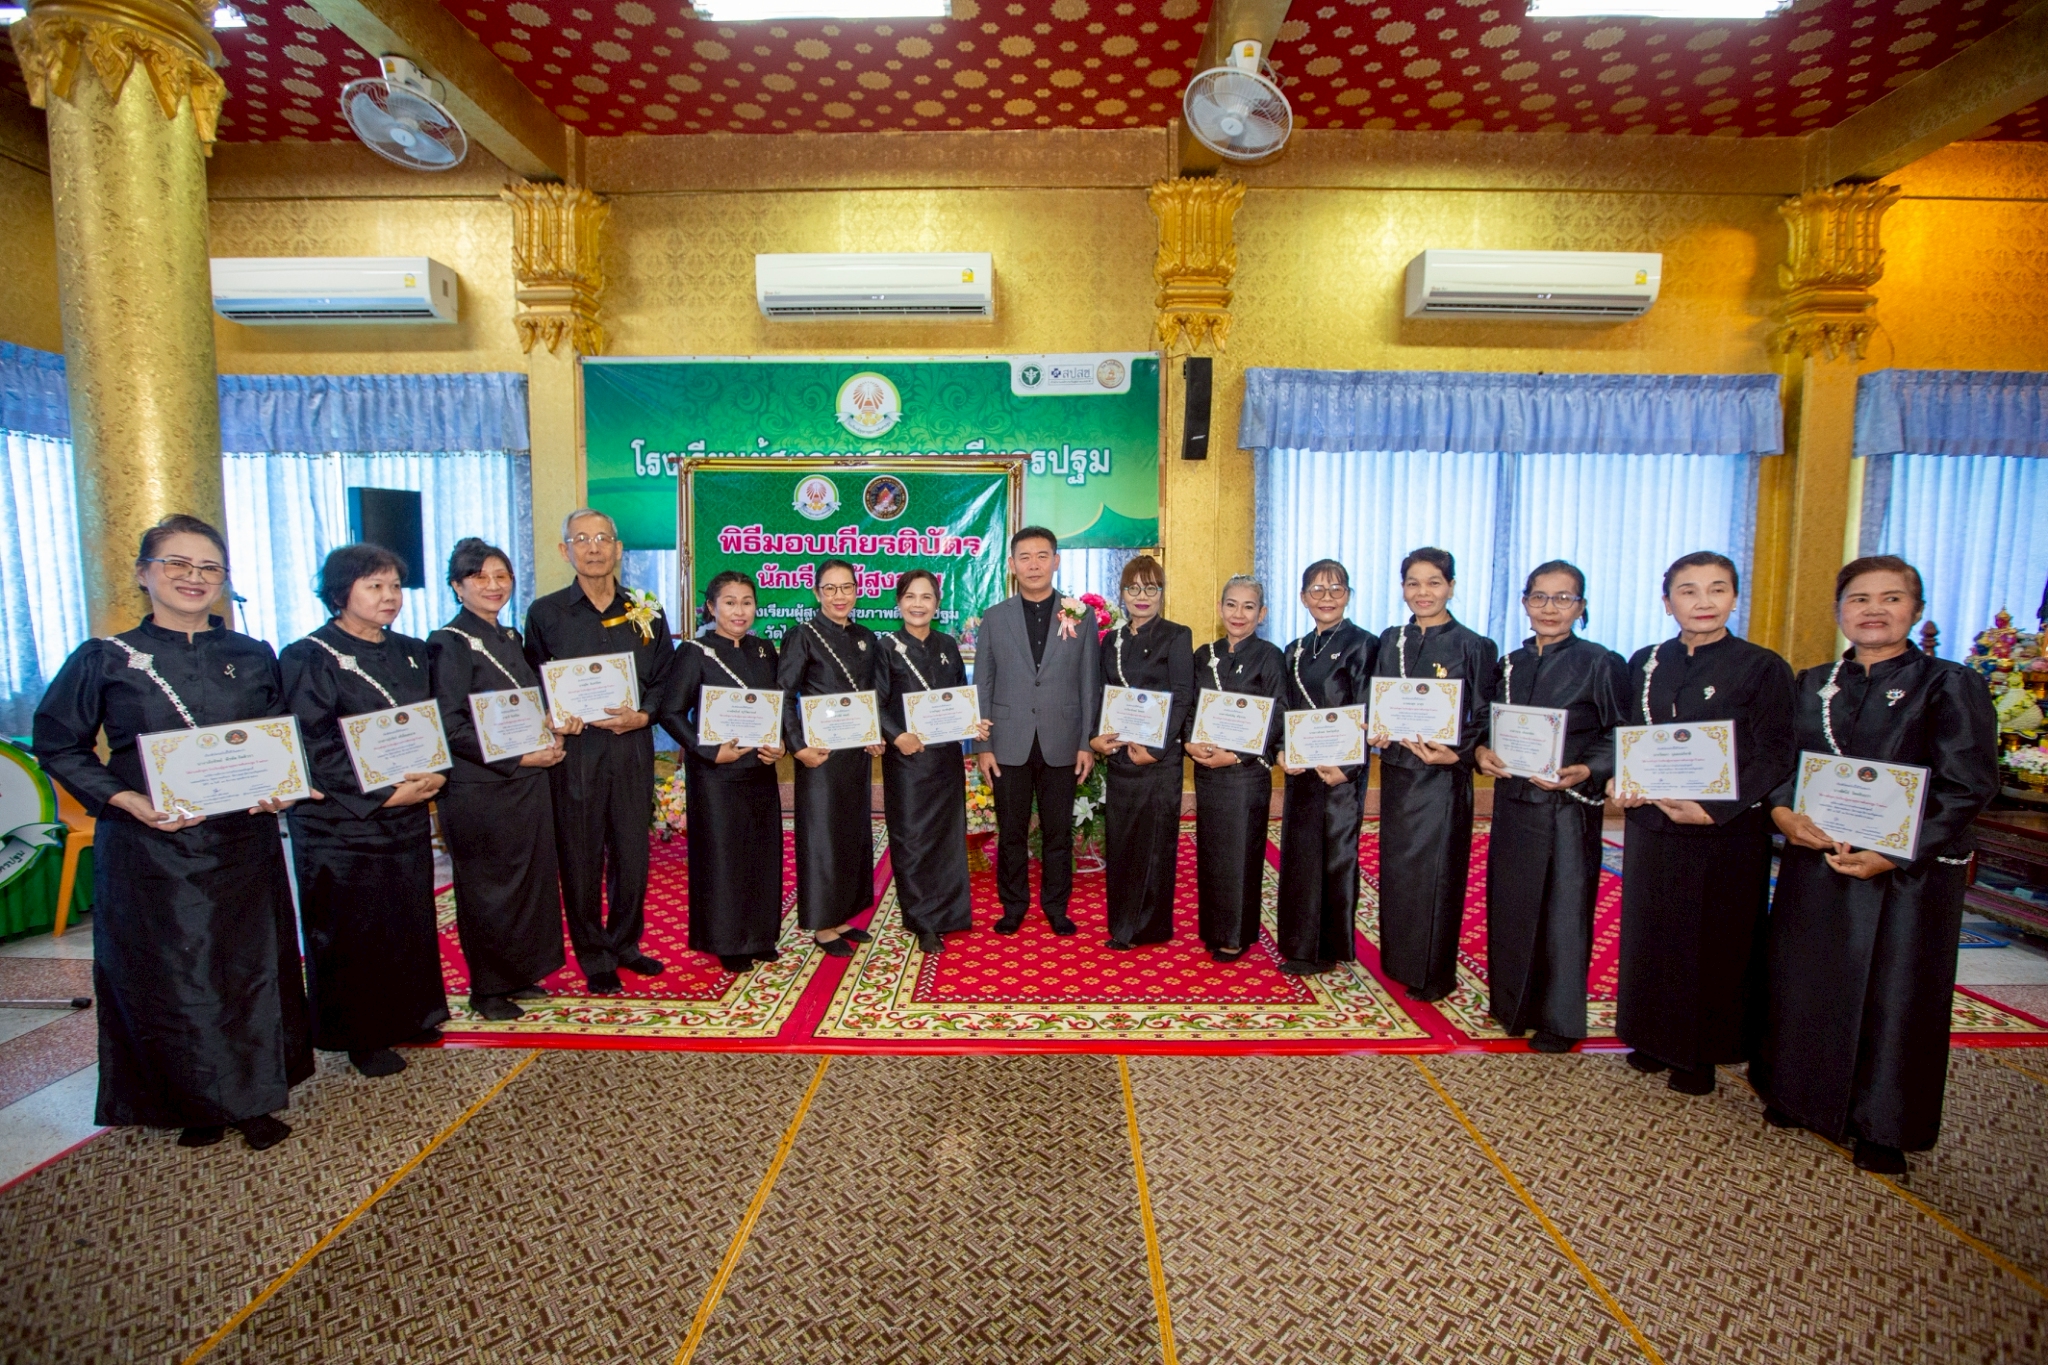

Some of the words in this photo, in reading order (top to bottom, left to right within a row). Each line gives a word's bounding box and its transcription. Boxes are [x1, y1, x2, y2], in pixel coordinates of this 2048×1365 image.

[718, 525, 982, 557] พิธีมอบเกียรติบัตร
